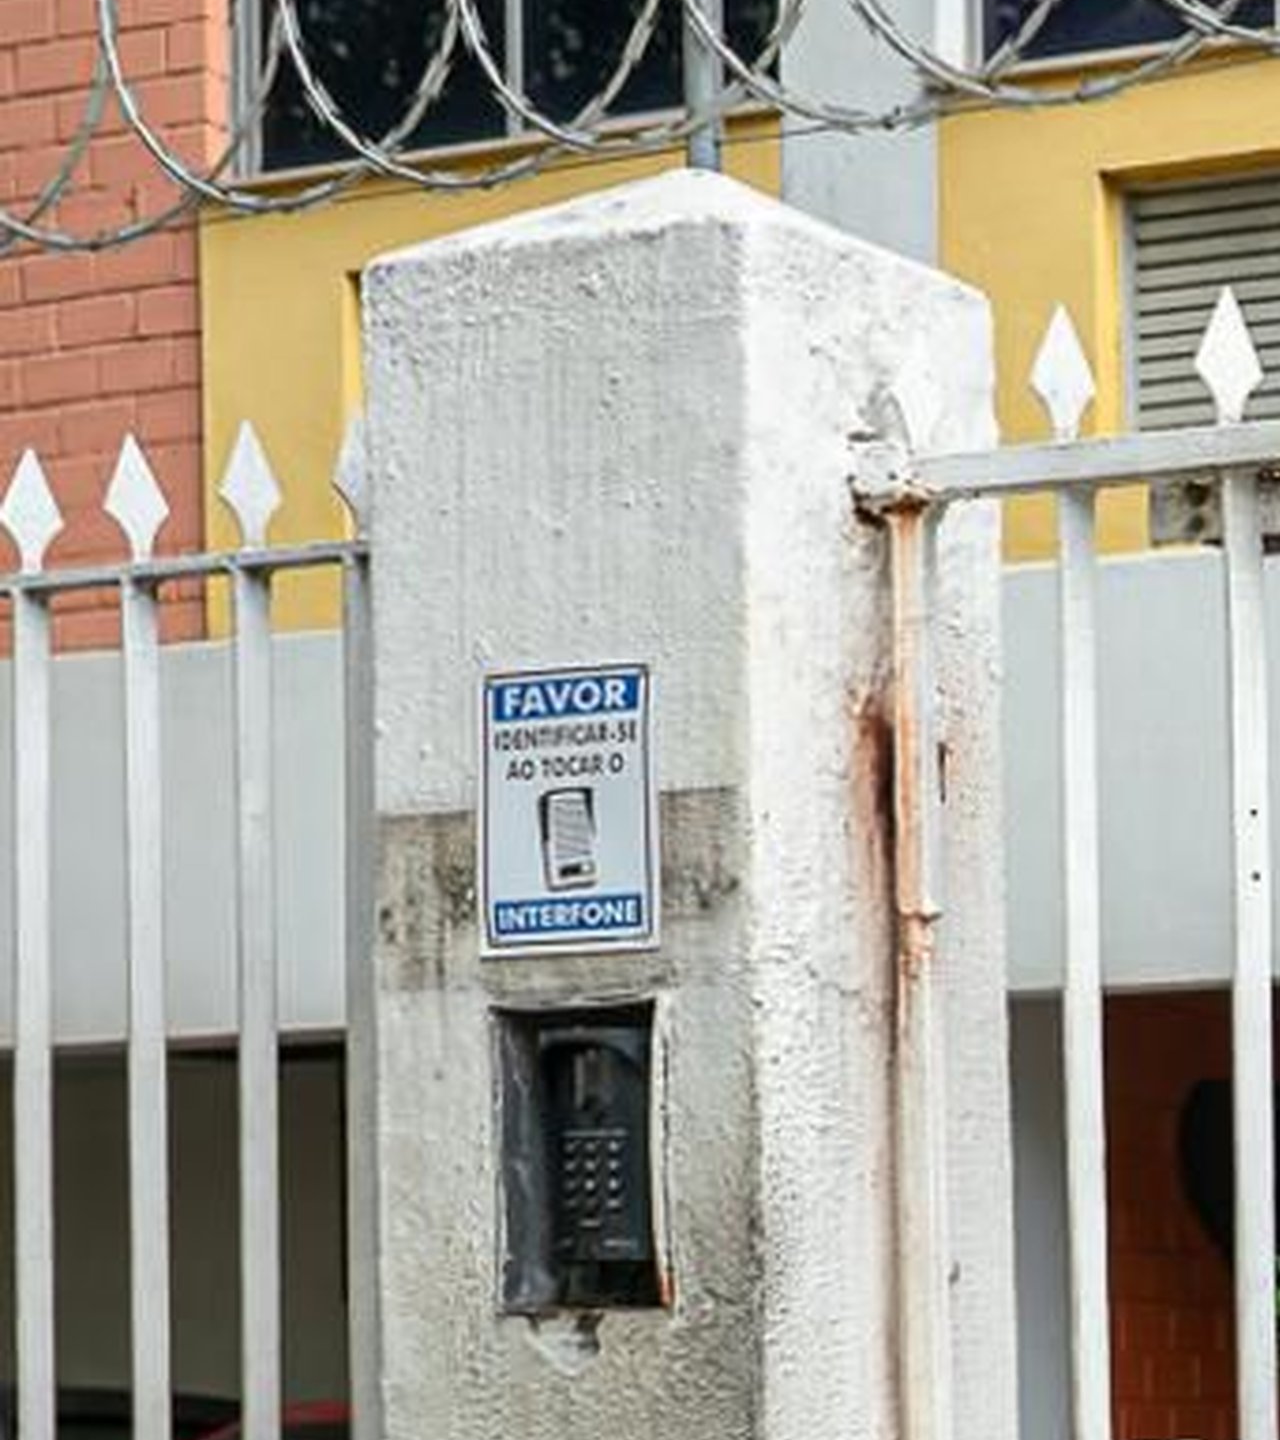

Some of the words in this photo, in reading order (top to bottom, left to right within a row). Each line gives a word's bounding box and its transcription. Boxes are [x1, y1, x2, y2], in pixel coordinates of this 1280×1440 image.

[502, 675, 628, 718] FAVOR
[505, 759, 536, 781] AO
[541, 755, 601, 779] TOCAR
[608, 752, 624, 774] O
[498, 898, 638, 934] INTERFONE
